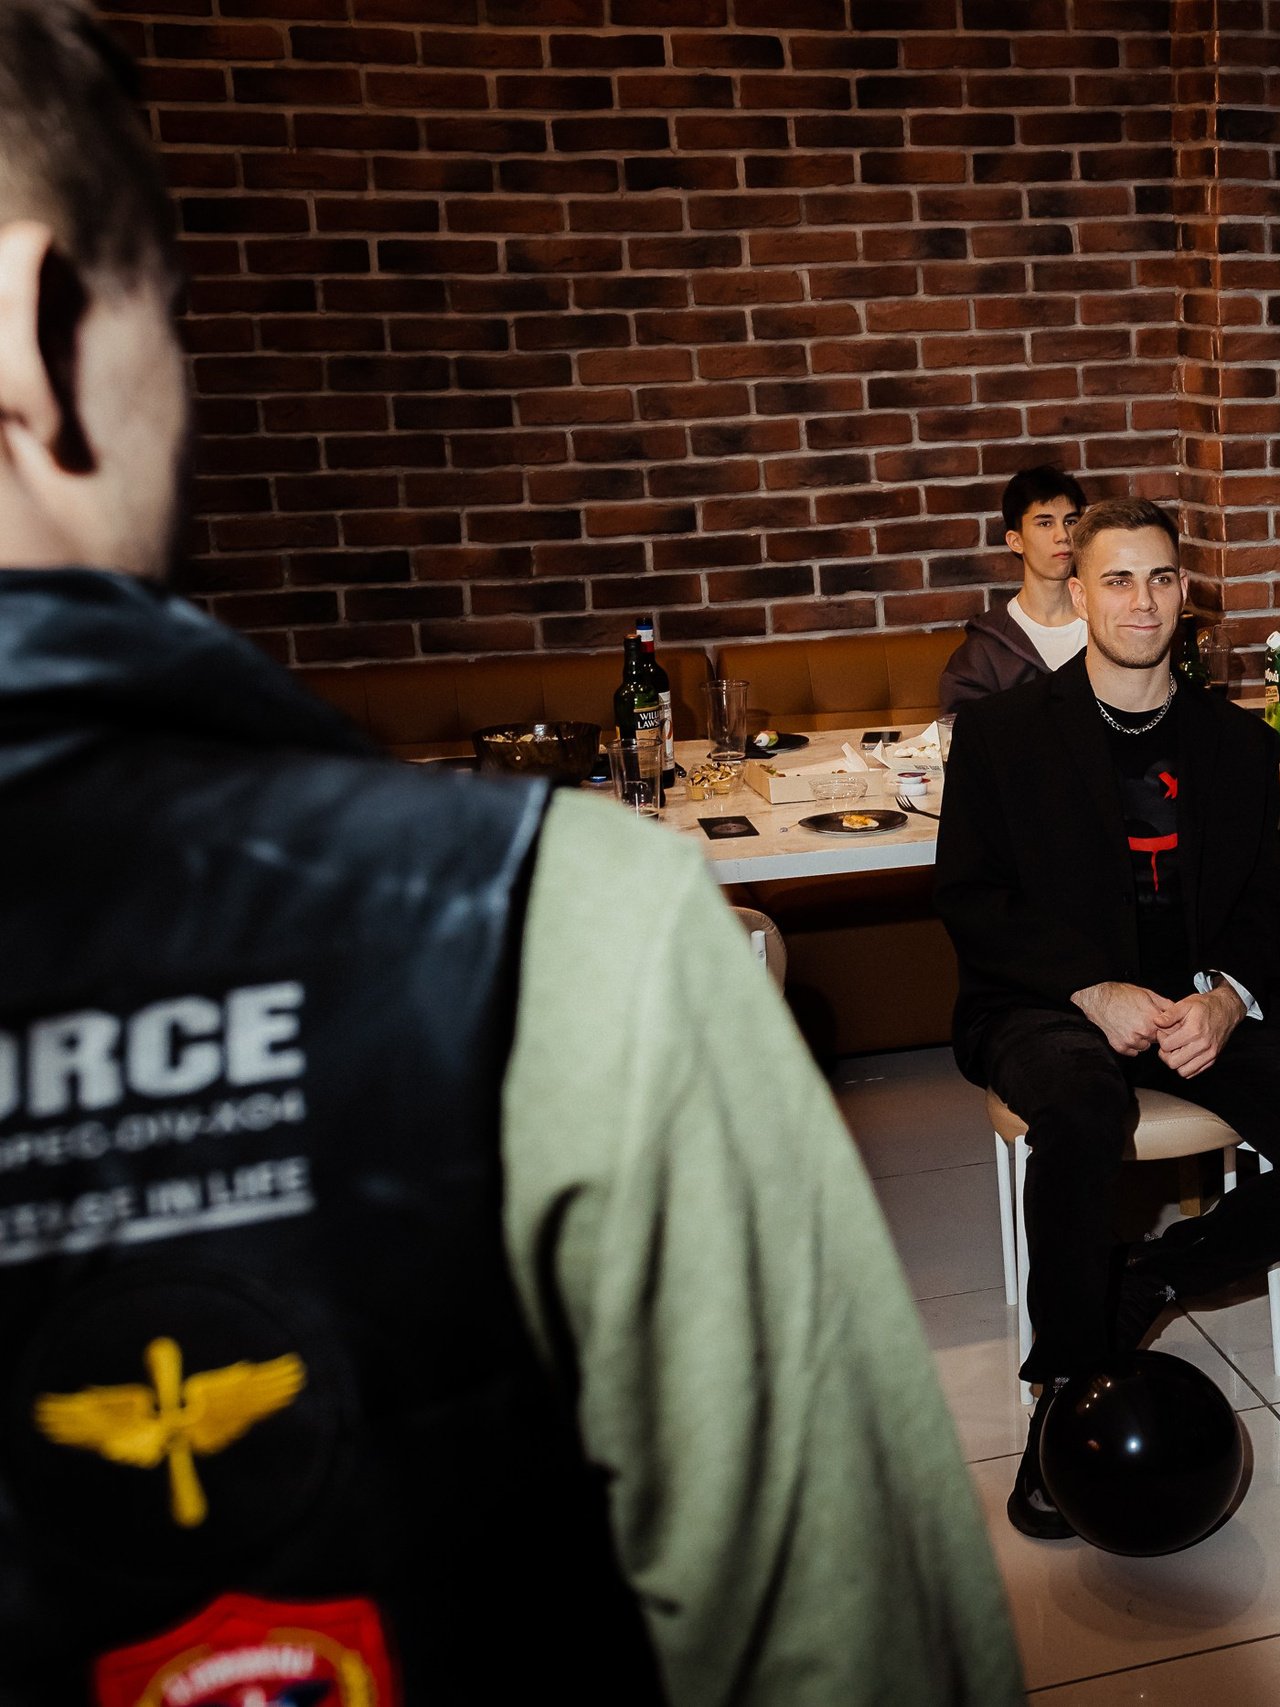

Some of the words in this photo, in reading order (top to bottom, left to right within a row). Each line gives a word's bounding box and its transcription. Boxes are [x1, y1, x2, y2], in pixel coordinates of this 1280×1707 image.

[0, 980, 306, 1121] RCE
[145, 1178, 200, 1213] IN
[206, 1157, 309, 1204] LIFE
